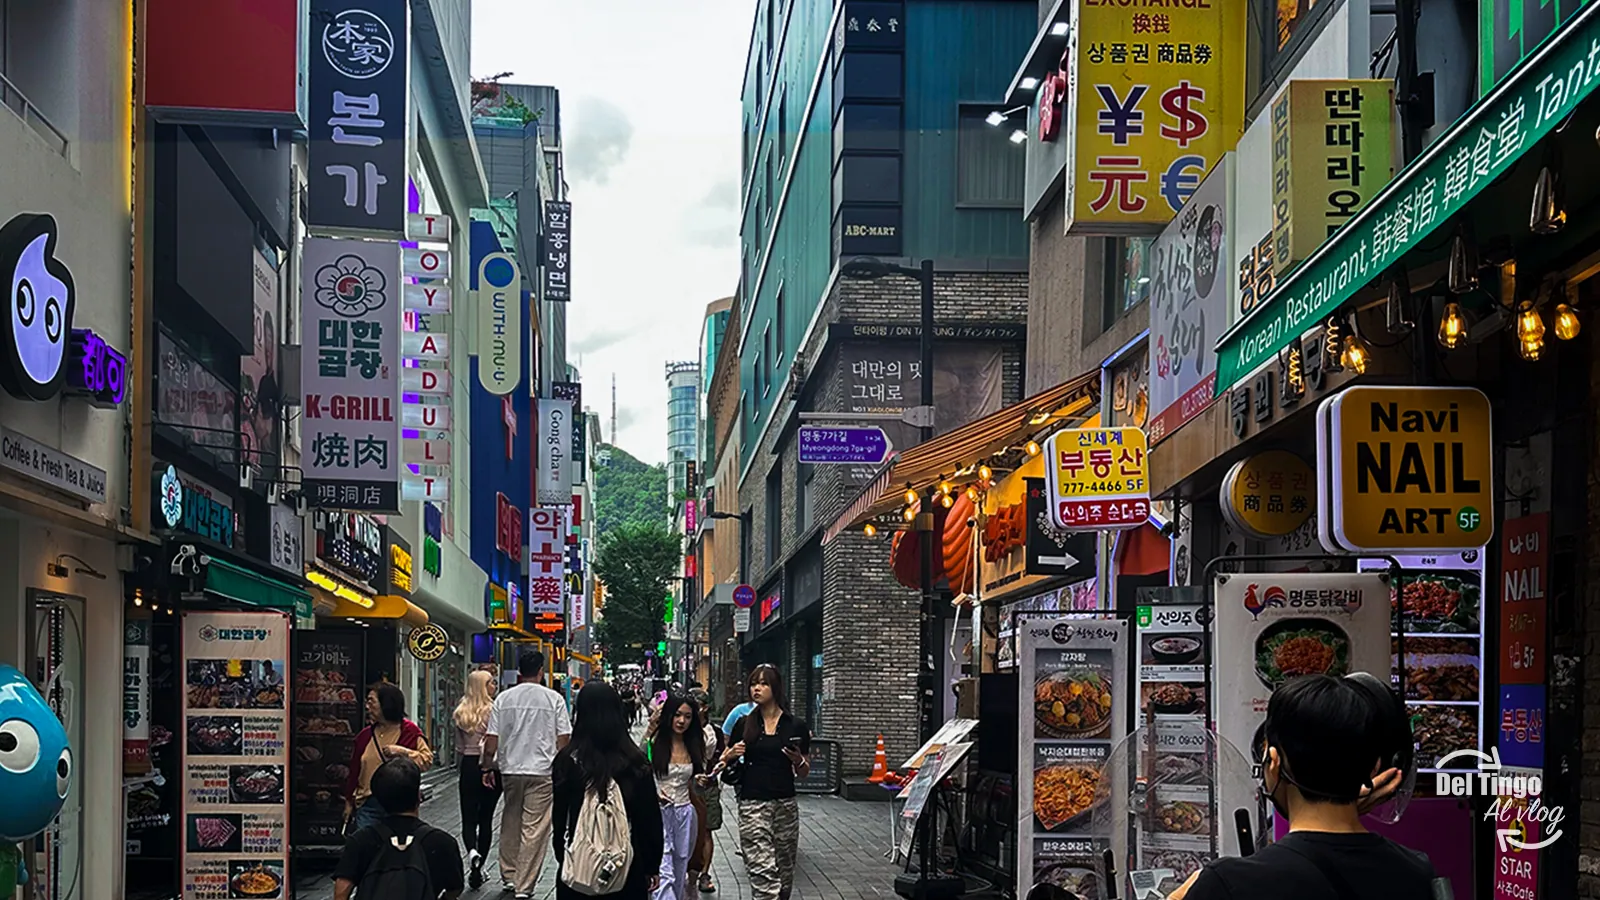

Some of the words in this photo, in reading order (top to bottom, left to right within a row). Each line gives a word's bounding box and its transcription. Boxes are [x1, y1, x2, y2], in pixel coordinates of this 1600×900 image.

[1087, 43, 1149, 64] 상품권
[1157, 42, 1212, 64] 商品券
[327, 90, 388, 216] 본가
[1325, 88, 1365, 238] 딴따라오
[1089, 157, 1147, 213] 元
[845, 225, 896, 237] ABC-MART
[548, 212, 569, 288] 함흥냉면
[318, 320, 383, 349] 대한
[853, 325, 888, 337] 딘타이펑
[896, 326, 911, 336] DIN
[1237, 315, 1282, 370] Korean
[318, 349, 383, 380] 곱창
[851, 359, 902, 381] 대만의
[851, 384, 904, 403] 그대로
[305, 394, 394, 422] K-GRILL
[1370, 402, 1460, 433] Navi
[547, 409, 564, 445] Gong
[801, 431, 848, 442] 명동7가길
[1077, 430, 1124, 446] 신세계
[550, 446, 564, 469] cha
[802, 444, 849, 453] Myeongdong
[851, 444, 877, 453] 7ga-gil
[2, 437, 30, 467] Coffee
[32, 445, 40, 464] &
[41, 451, 63, 478] Fresh
[64, 463, 78, 483] Tea
[78, 468, 86, 487] &
[87, 471, 105, 496] Juice
[1059, 447, 1144, 478] 부동산
[1356, 441, 1481, 494] NAIL
[1063, 480, 1122, 493] 777-4466
[1126, 478, 1144, 491] 5F
[1243, 470, 1309, 490] 상품권
[1062, 505, 1102, 523] 신의주
[1107, 502, 1148, 520] 순대국
[1242, 494, 1309, 514] 商品券
[532, 511, 562, 540] 약
[1377, 508, 1452, 535] ART
[1459, 512, 1480, 529] 5F
[1508, 531, 1540, 555] 나비
[1463, 550, 1476, 560] 2F
[1504, 566, 1544, 602] NAIL
[1289, 589, 1363, 608] 명동닭갈비
[1156, 611, 1193, 626] 신의주
[412, 646, 441, 661] COFFEE
[1060, 652, 1087, 662] 감자탕
[1522, 645, 1536, 669] 5F
[1500, 707, 1543, 744] 부동산
[1500, 856, 1533, 879] STAR
[1496, 879, 1536, 900] 사주Cafe
